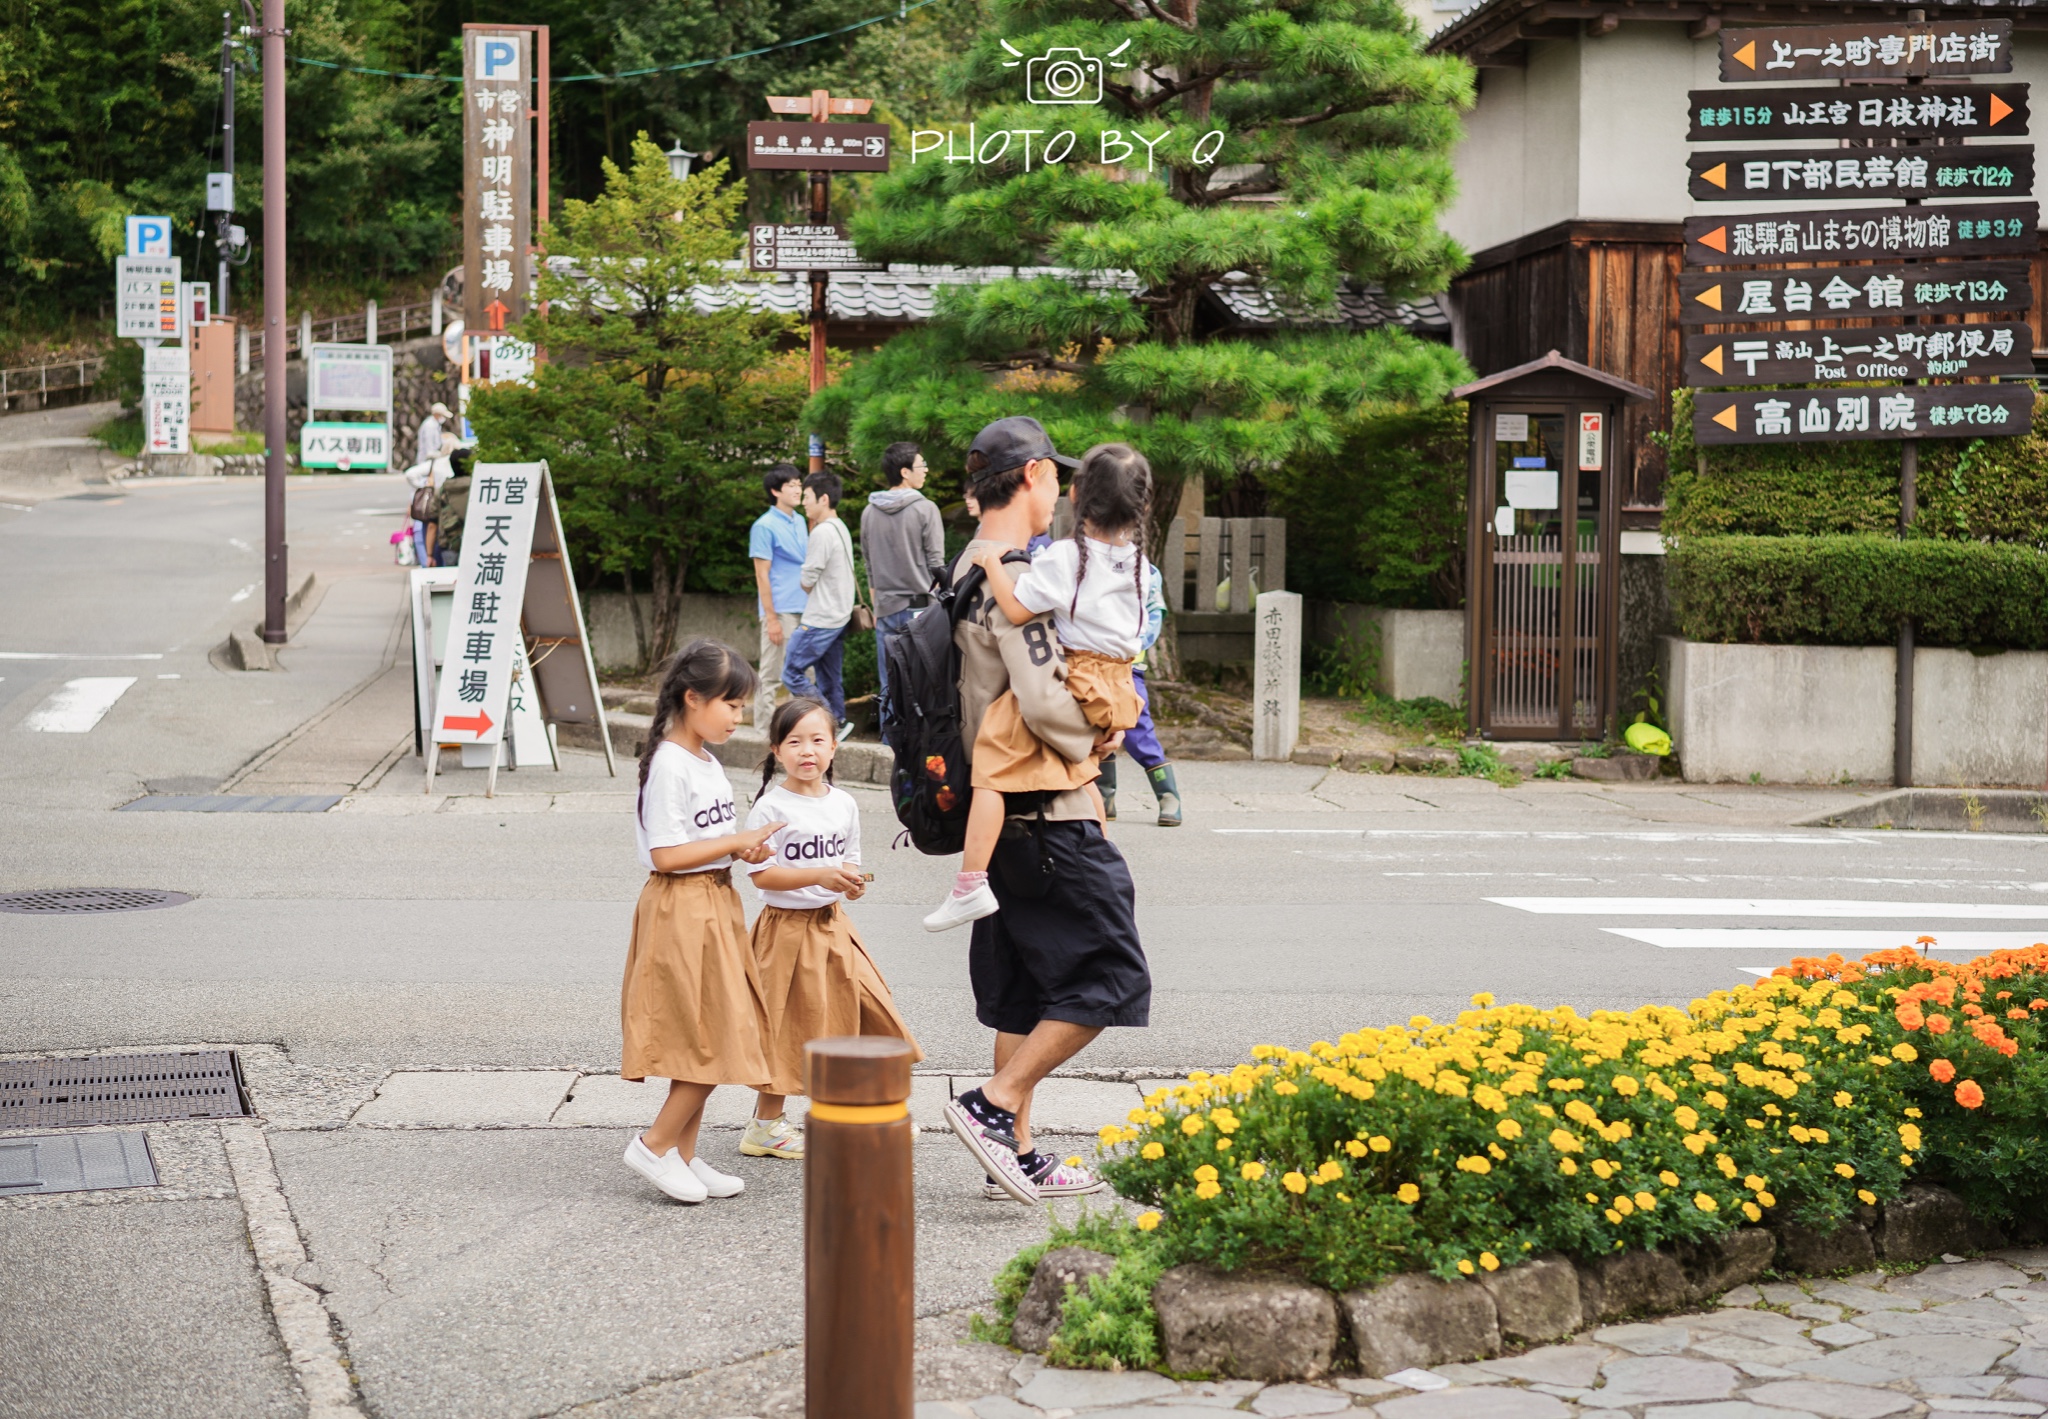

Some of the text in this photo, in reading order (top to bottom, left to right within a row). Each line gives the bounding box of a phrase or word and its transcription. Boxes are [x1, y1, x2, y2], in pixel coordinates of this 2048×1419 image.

[485, 42, 516, 76] P
[1766, 31, 2001, 70] 上一之町専門店街
[474, 88, 522, 114] 市営
[1699, 107, 1773, 127] 徒歩15分
[1743, 155, 2015, 191] 日下部民芸館 徒歩で12分
[480, 118, 515, 292] 神明駐車場
[138, 223, 163, 254] P
[1957, 218, 2024, 239] 徒歩3分
[127, 282, 154, 293] バス
[1737, 274, 2009, 315] 屋台会館 徒歩で13分
[1814, 362, 1909, 380] Post Office
[1753, 392, 2010, 436] 高山別院 徒歩で8分
[308, 437, 382, 455] バス専用
[478, 476, 528, 505] 市営
[458, 515, 512, 703] 天満駐車場
